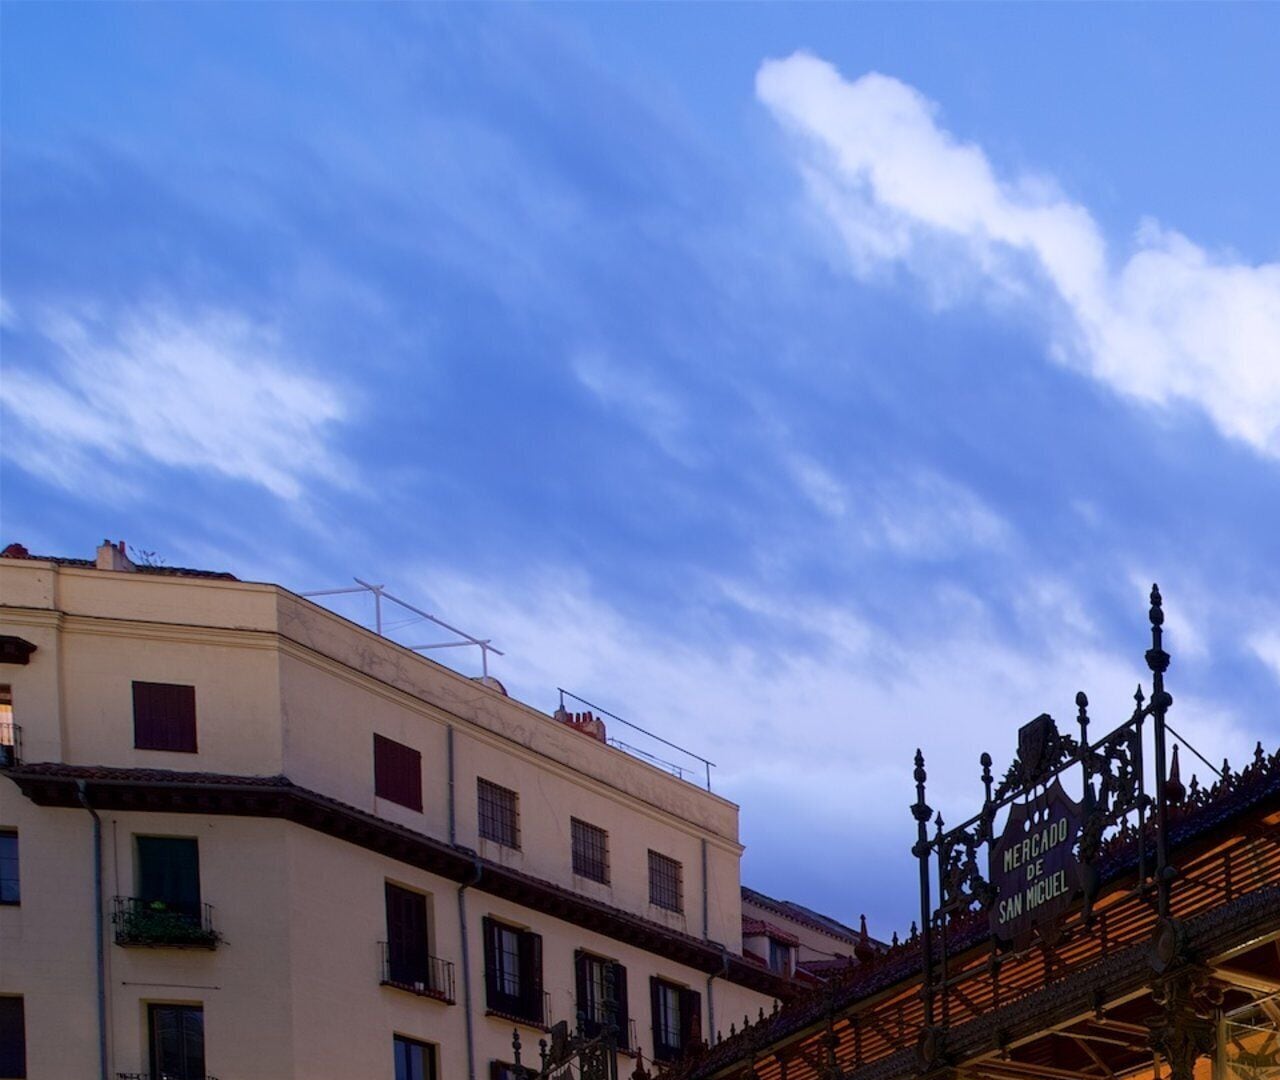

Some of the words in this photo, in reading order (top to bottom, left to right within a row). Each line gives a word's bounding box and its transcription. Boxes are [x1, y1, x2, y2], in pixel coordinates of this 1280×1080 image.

[1003, 817, 1068, 873] MERCADO
[1027, 858, 1044, 881] DE
[999, 892, 1022, 924] SAN
